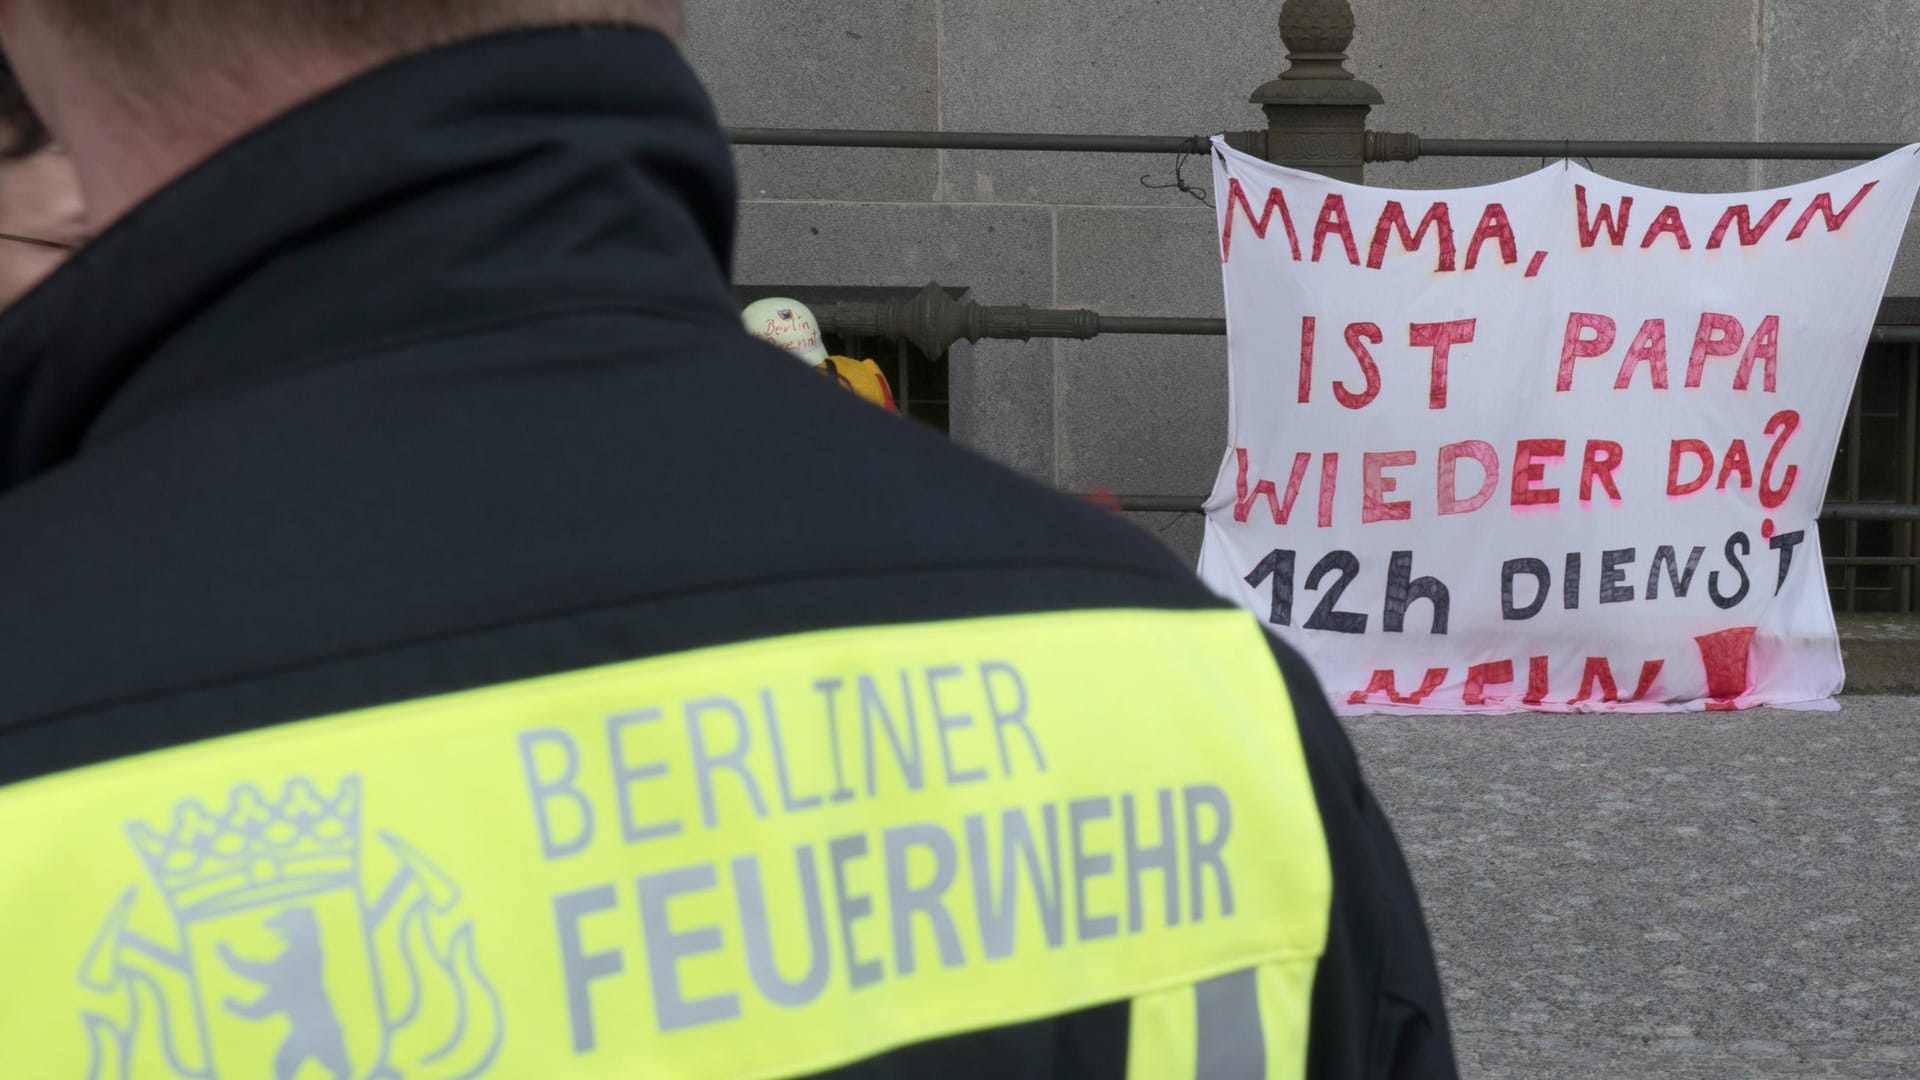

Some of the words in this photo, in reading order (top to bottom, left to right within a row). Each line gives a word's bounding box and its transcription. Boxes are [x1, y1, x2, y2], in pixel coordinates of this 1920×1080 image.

[1223, 178, 1548, 277] MAMA,
[1575, 180, 1879, 249] WANN
[765, 315, 810, 336] Berlin
[1298, 316, 1476, 409] IST
[1556, 312, 1779, 393] PAPA
[1234, 439, 1624, 528] WIEDER
[1667, 410, 1801, 539] DA?
[1243, 549, 1451, 634] 12h
[1501, 530, 1804, 621] DIENST
[516, 660, 1048, 861] BERLINER
[551, 783, 1236, 1055] FEUERWEHR
